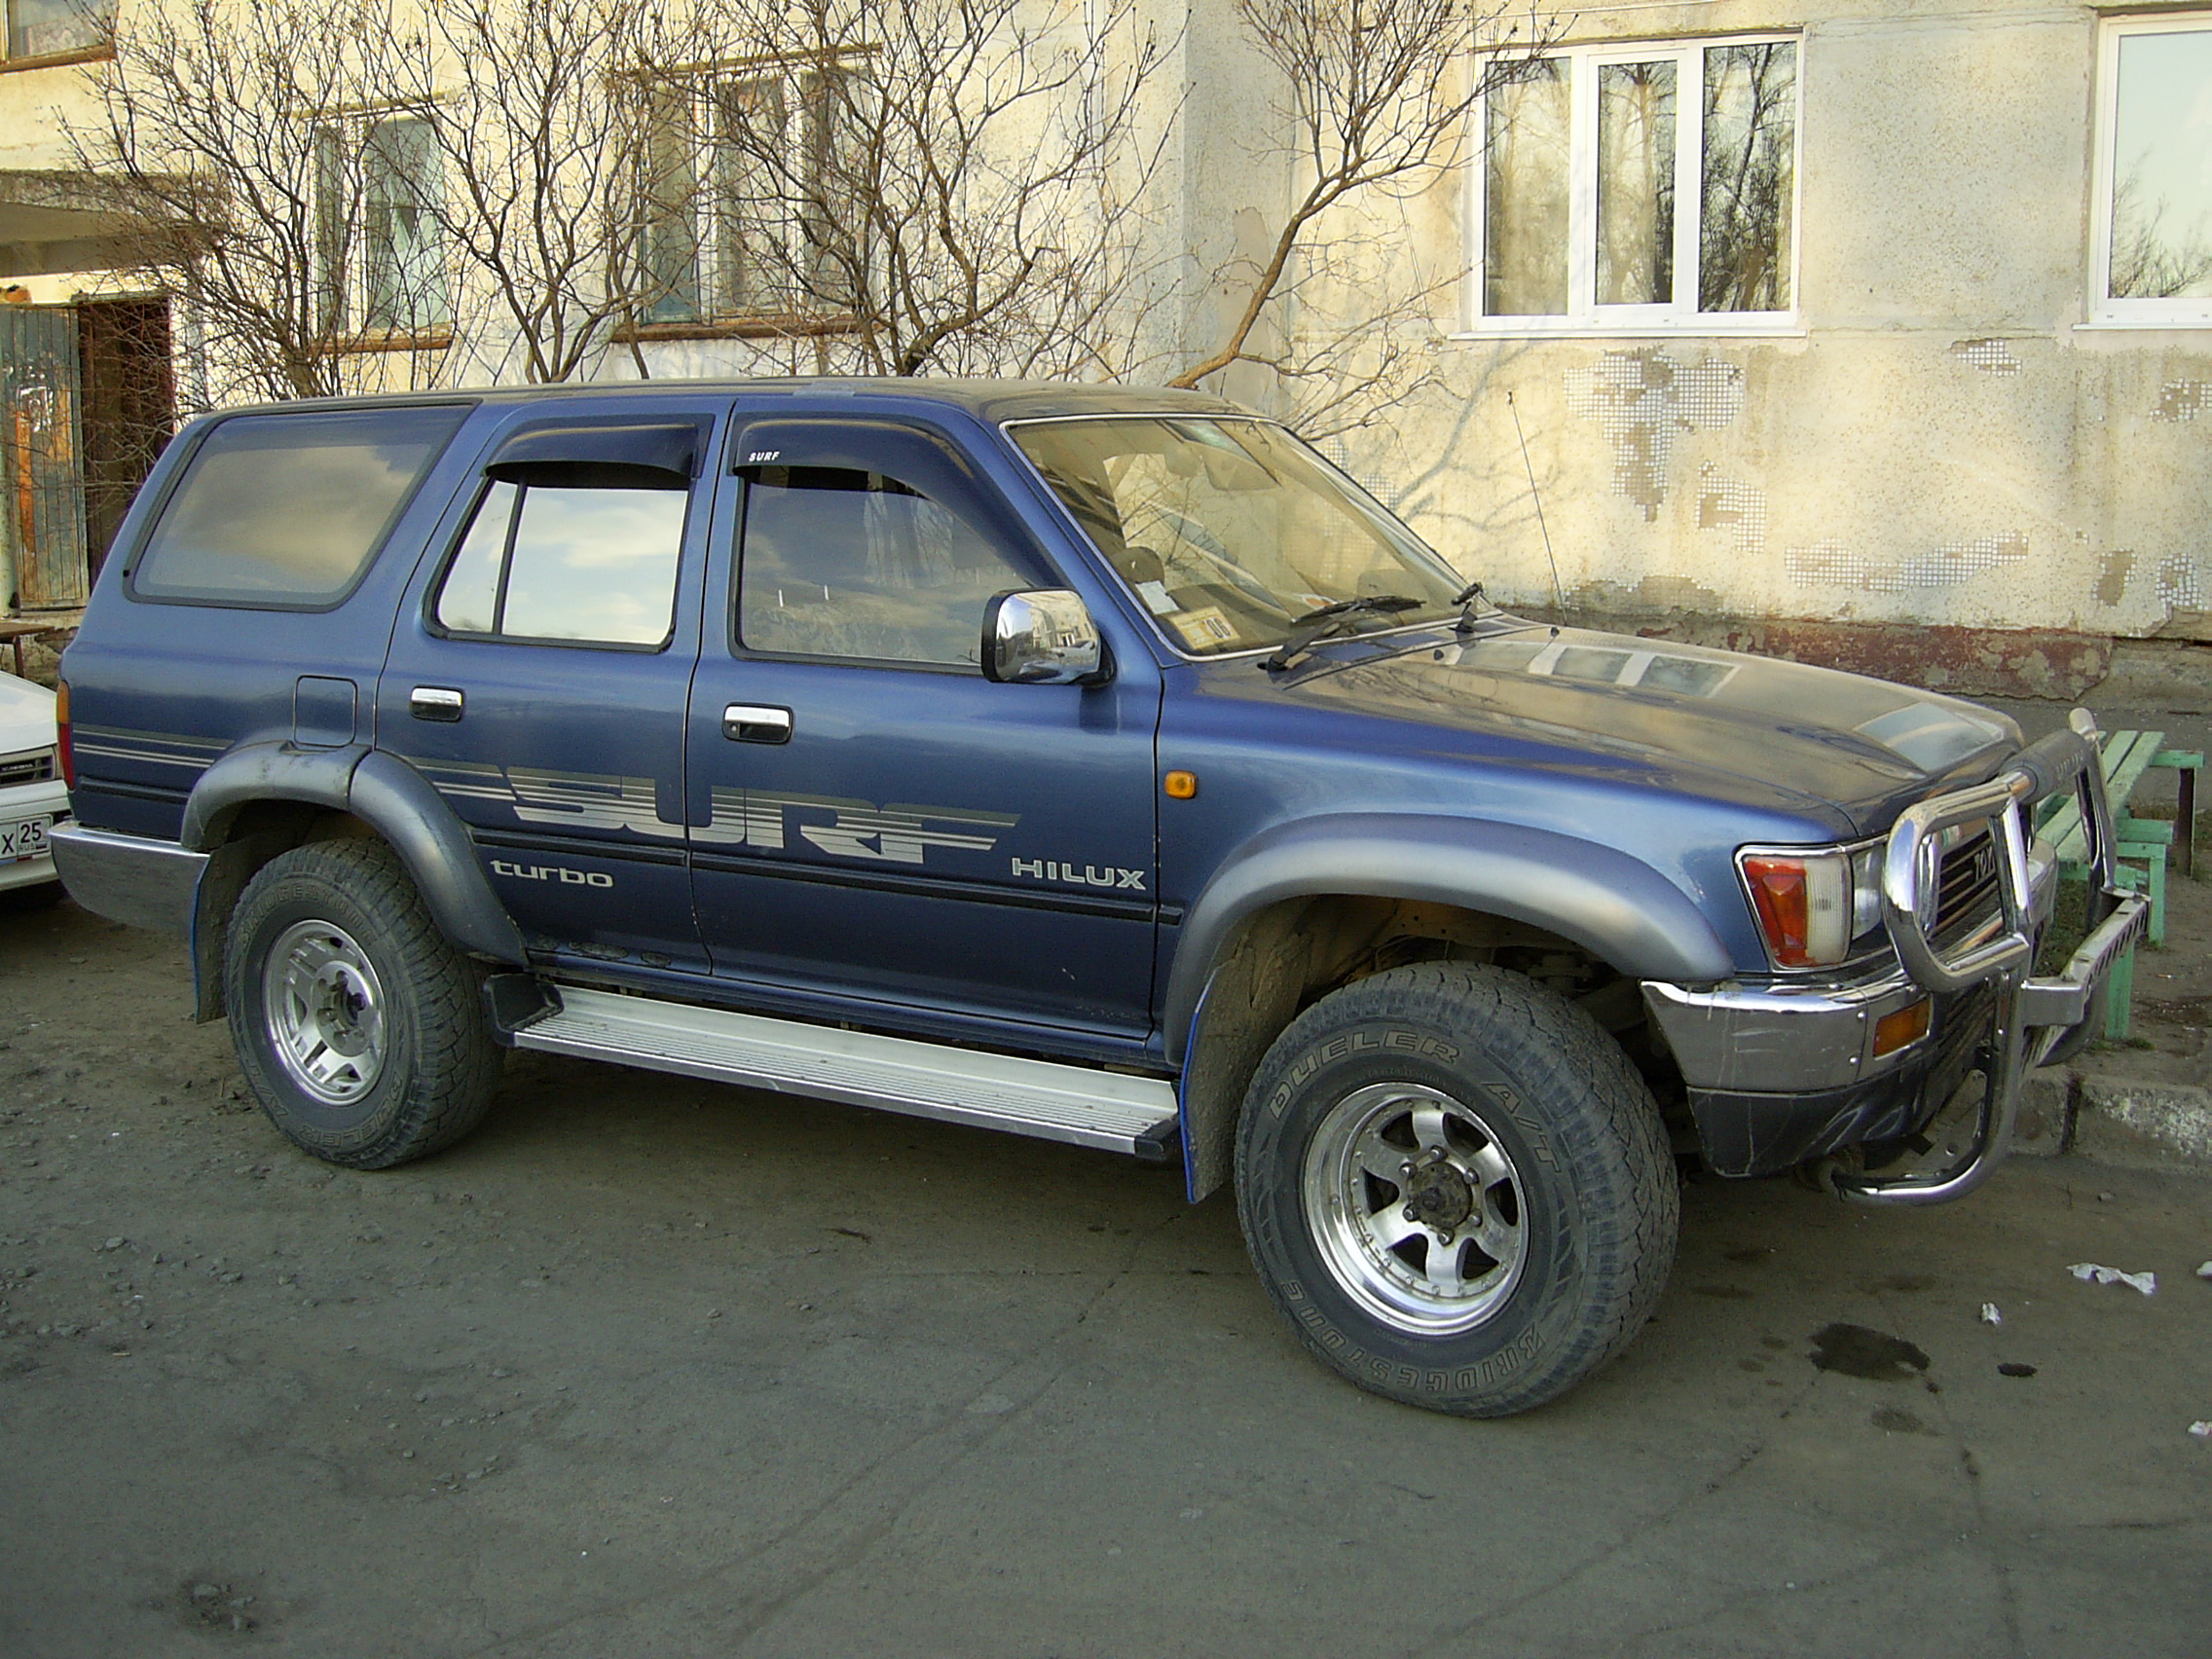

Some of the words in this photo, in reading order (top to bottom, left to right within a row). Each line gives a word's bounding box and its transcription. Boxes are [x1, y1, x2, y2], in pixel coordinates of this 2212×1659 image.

[749, 451, 780, 462] SURF
[19, 822, 42, 843] 25
[505, 765, 1021, 865] SURF
[490, 859, 613, 888] turbo
[1012, 857, 1147, 891] HILUX
[297, 1070, 404, 1149] DUELER
[1268, 1029, 1461, 1120] DUELER
[1481, 1082, 1560, 1173] A/T
[1281, 1279, 1547, 1393] BRIDGESTONE
